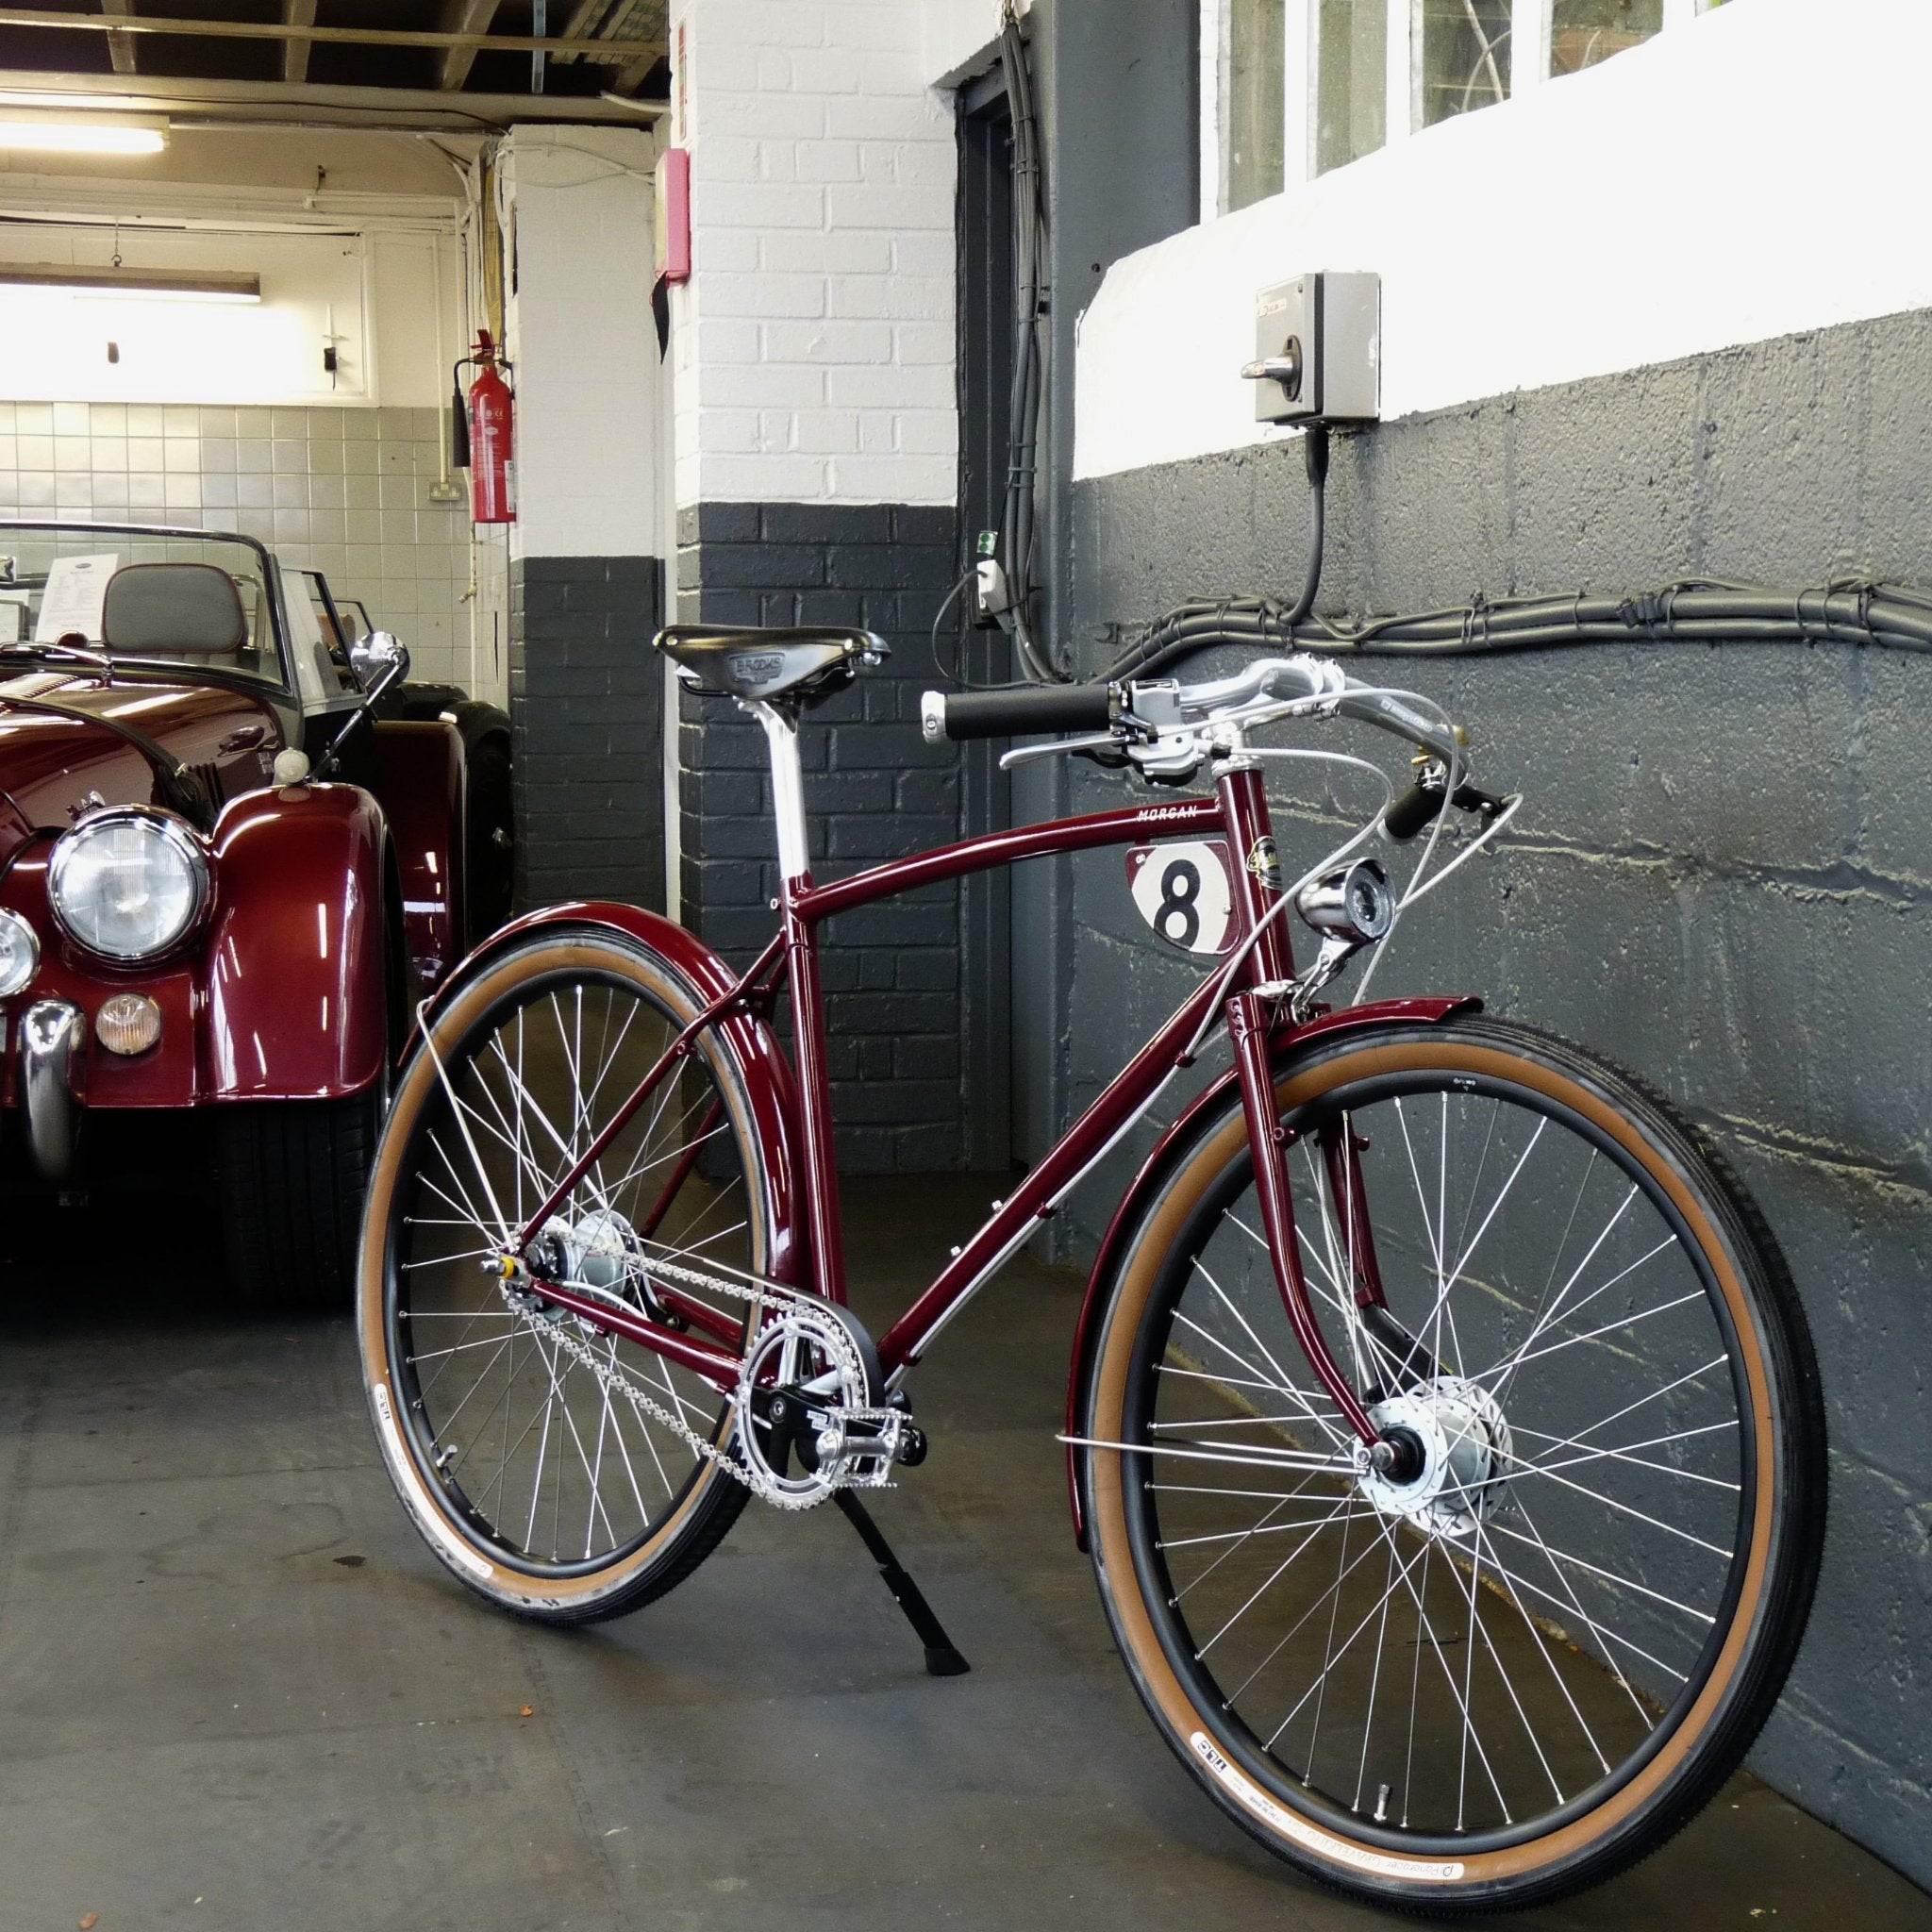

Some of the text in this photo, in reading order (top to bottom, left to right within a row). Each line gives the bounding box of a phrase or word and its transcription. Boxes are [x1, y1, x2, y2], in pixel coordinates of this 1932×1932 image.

[736, 657, 781, 673] BROOKS
[1138, 805, 1197, 822] MORGAN
[1154, 859, 1201, 950] 8
